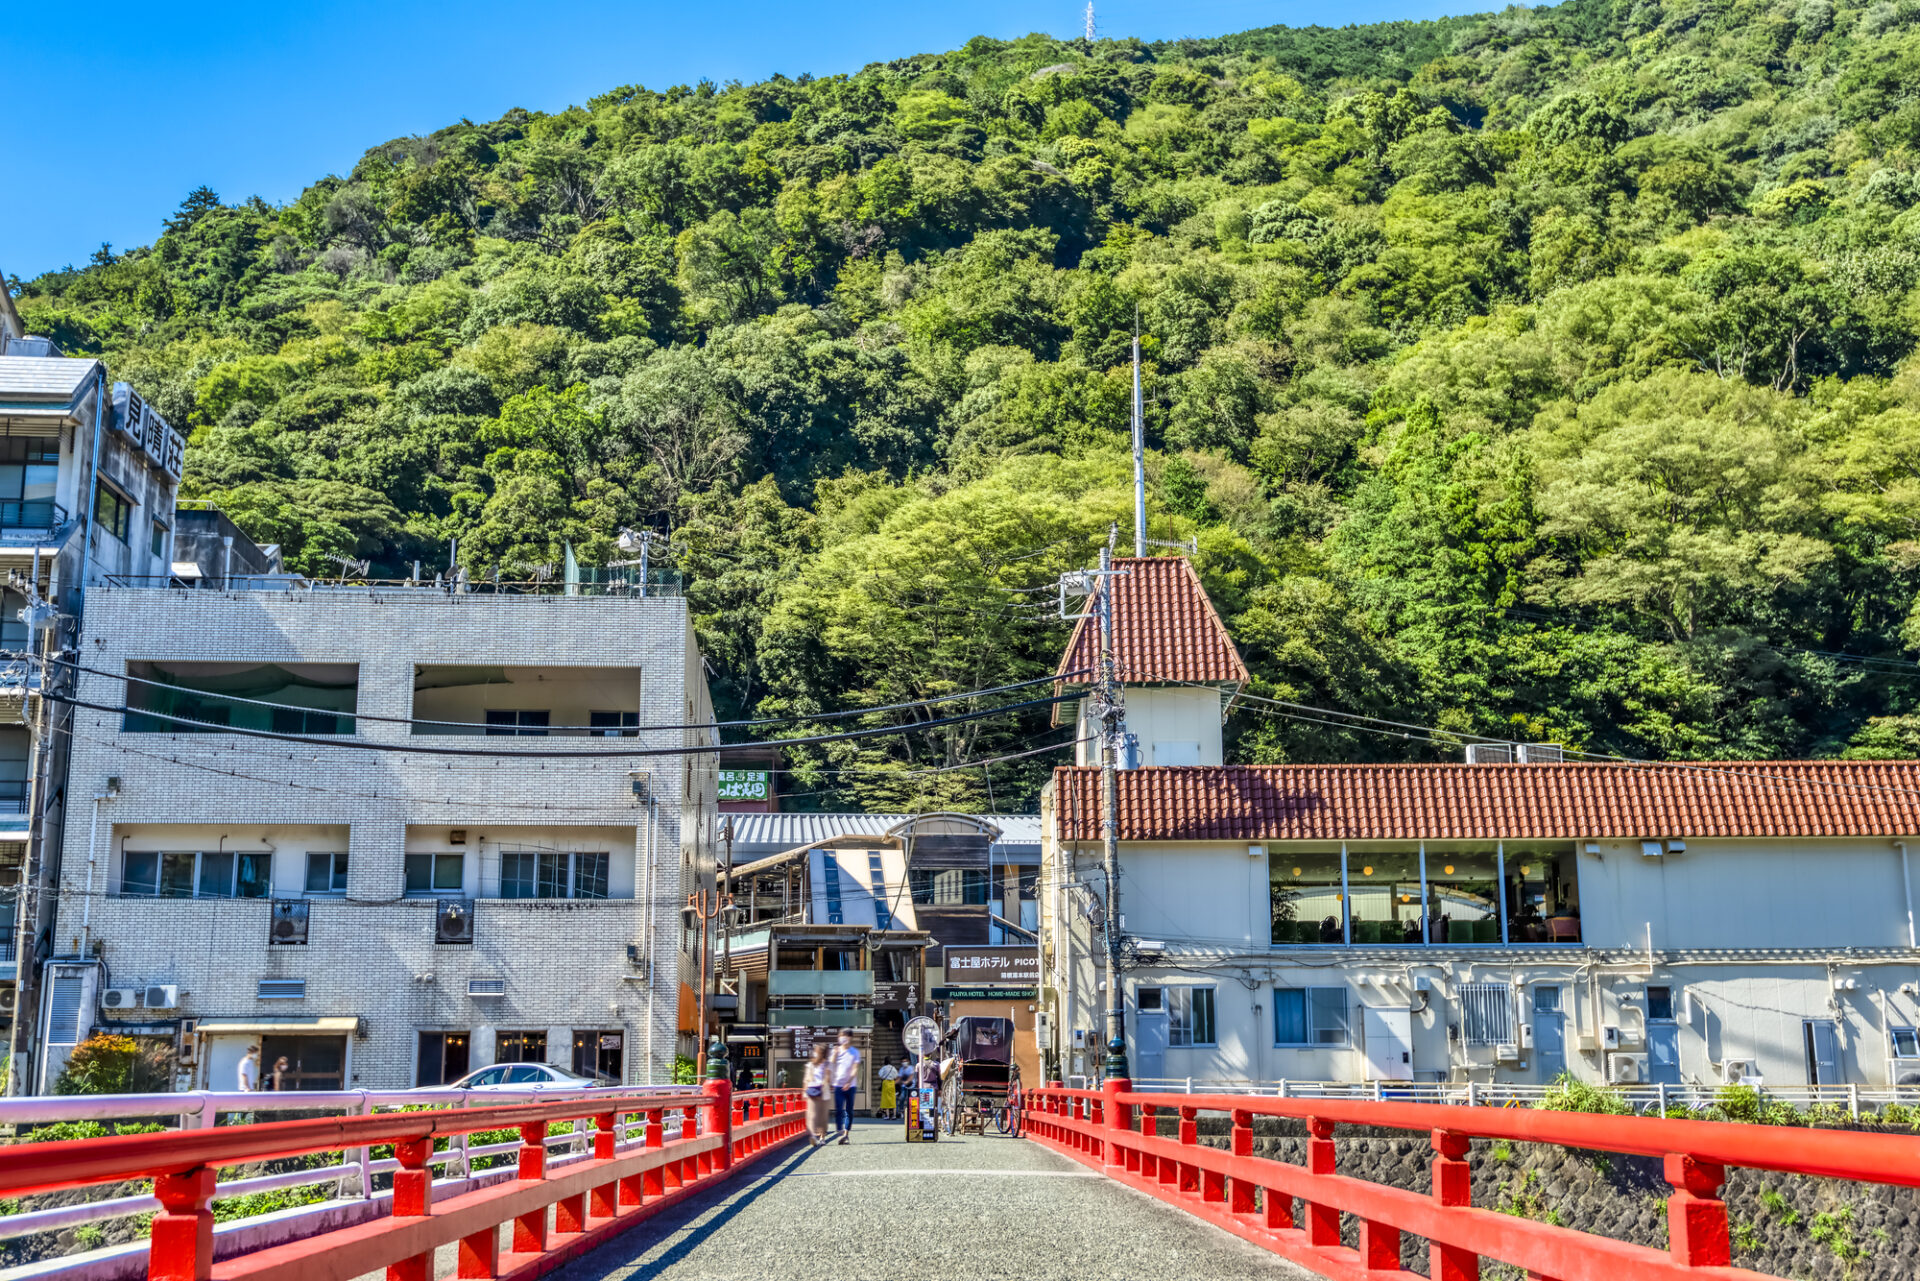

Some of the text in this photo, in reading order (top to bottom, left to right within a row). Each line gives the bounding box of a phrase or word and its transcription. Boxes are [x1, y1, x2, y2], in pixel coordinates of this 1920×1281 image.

[126, 391, 183, 478] 見晴荘
[950, 956, 1010, 969] 富士屋ホテル
